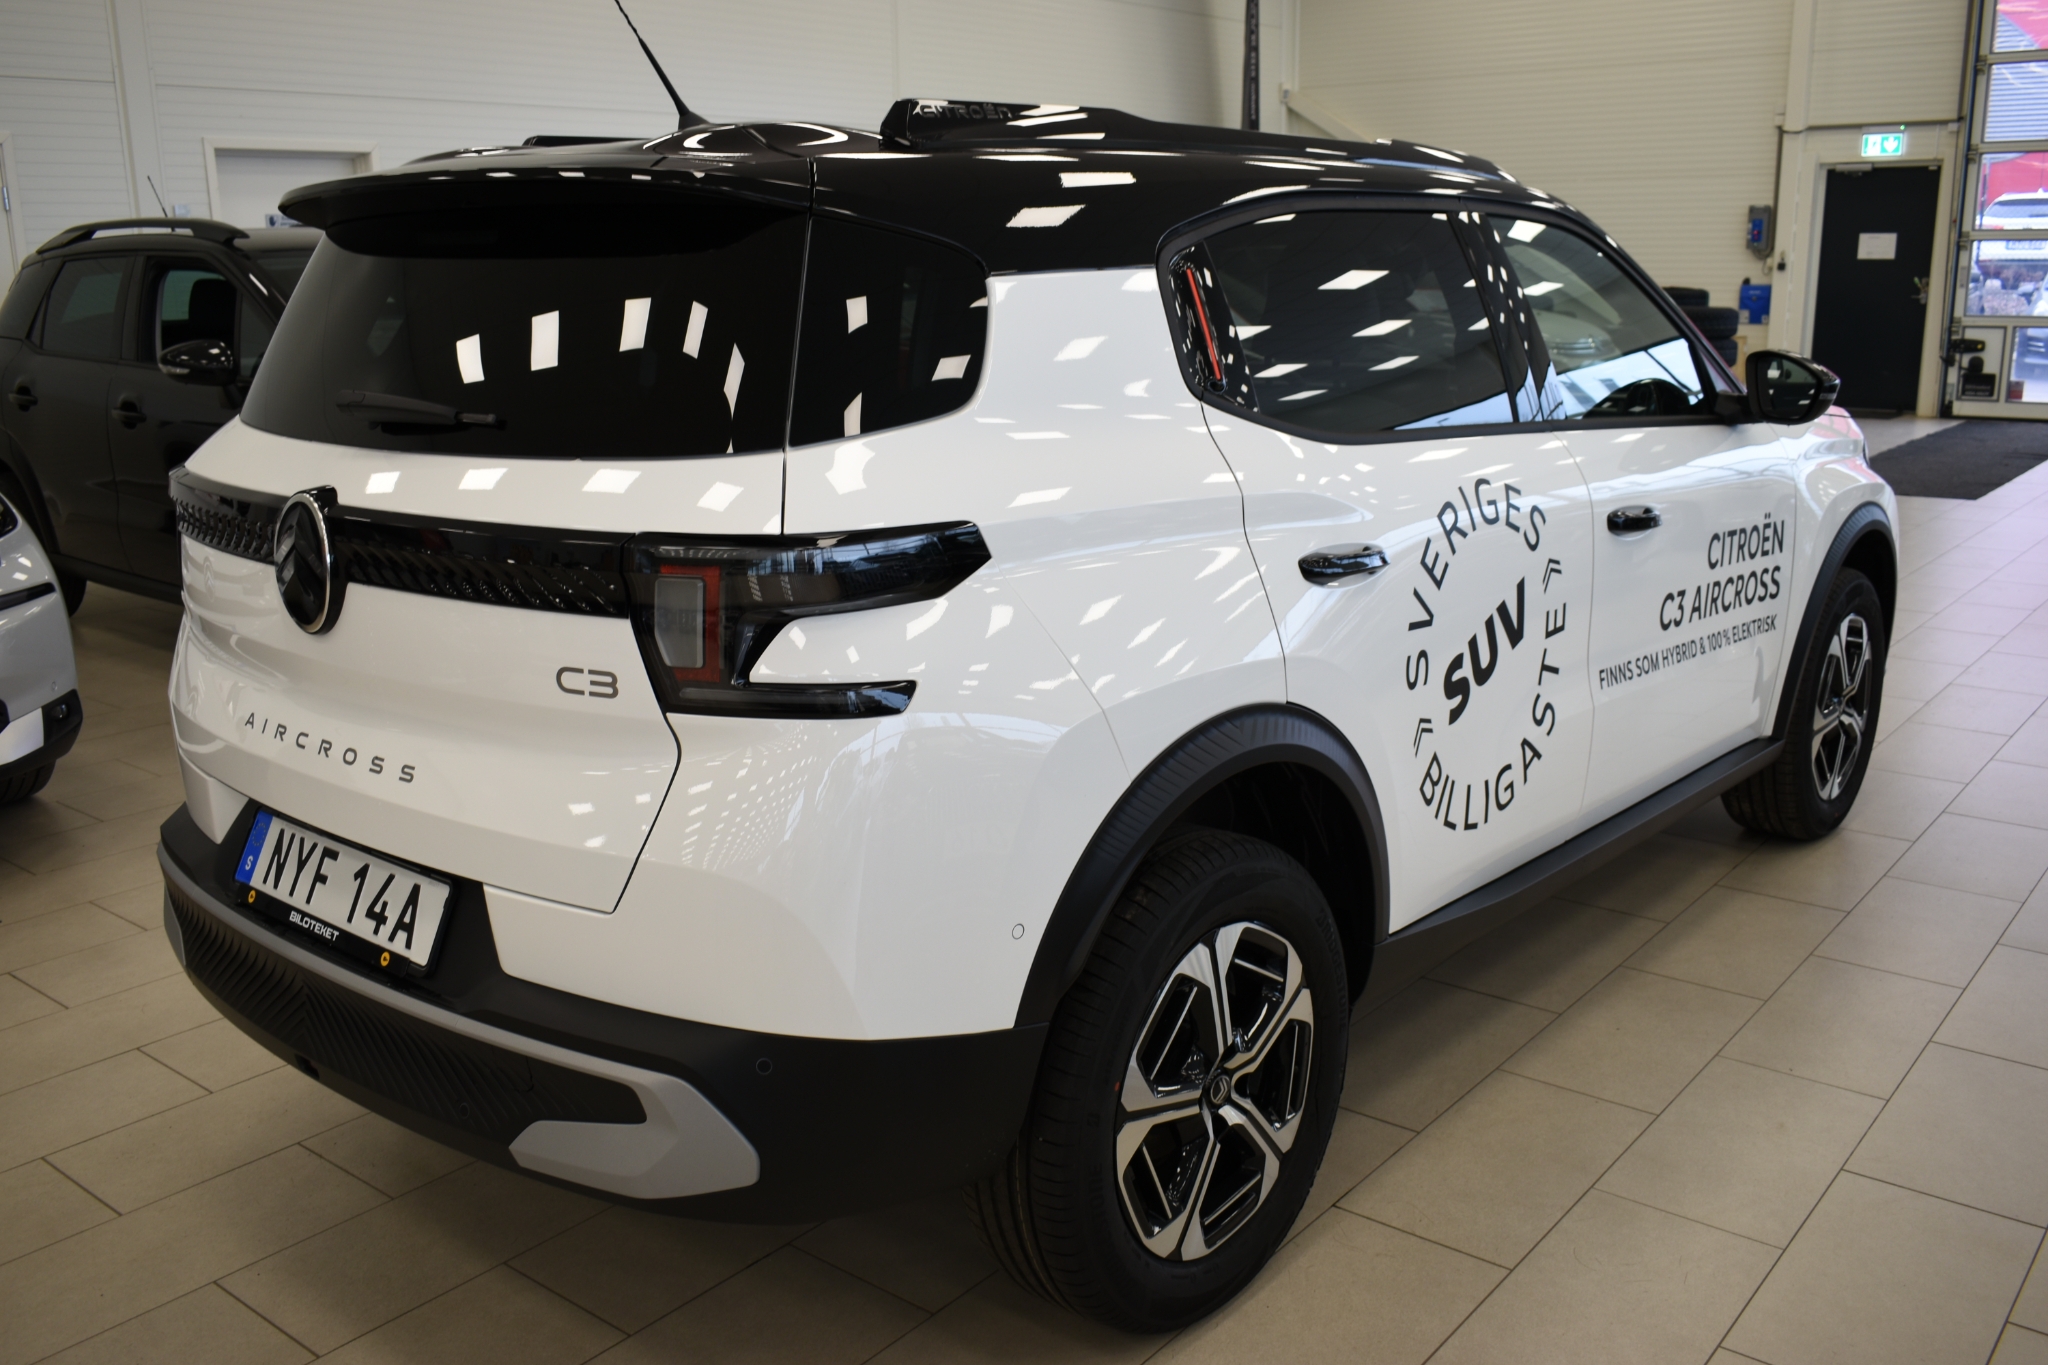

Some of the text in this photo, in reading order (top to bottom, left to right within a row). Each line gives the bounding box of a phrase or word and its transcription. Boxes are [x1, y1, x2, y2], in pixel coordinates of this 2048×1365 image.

[1708, 513, 1784, 570] CITROËN
[1406, 478, 1546, 690] SVERIGES
[1660, 565, 1781, 631] C3 AIRCROSS
[556, 666, 619, 699] C3
[1444, 576, 1525, 726] SUV
[1599, 660, 1634, 690] FINNS
[1635, 651, 1660, 677] SOM
[1662, 639, 1697, 668] HYBRID
[1699, 637, 1706, 655] &
[1732, 614, 1777, 643] ELEKTRISK
[244, 712, 416, 784] AIRCROSS
[1419, 602, 1566, 831] BILLIGASTE
[245, 855, 254, 871] S
[262, 828, 422, 951] NYF 14A
[289, 911, 340, 942] BILOTEKET
